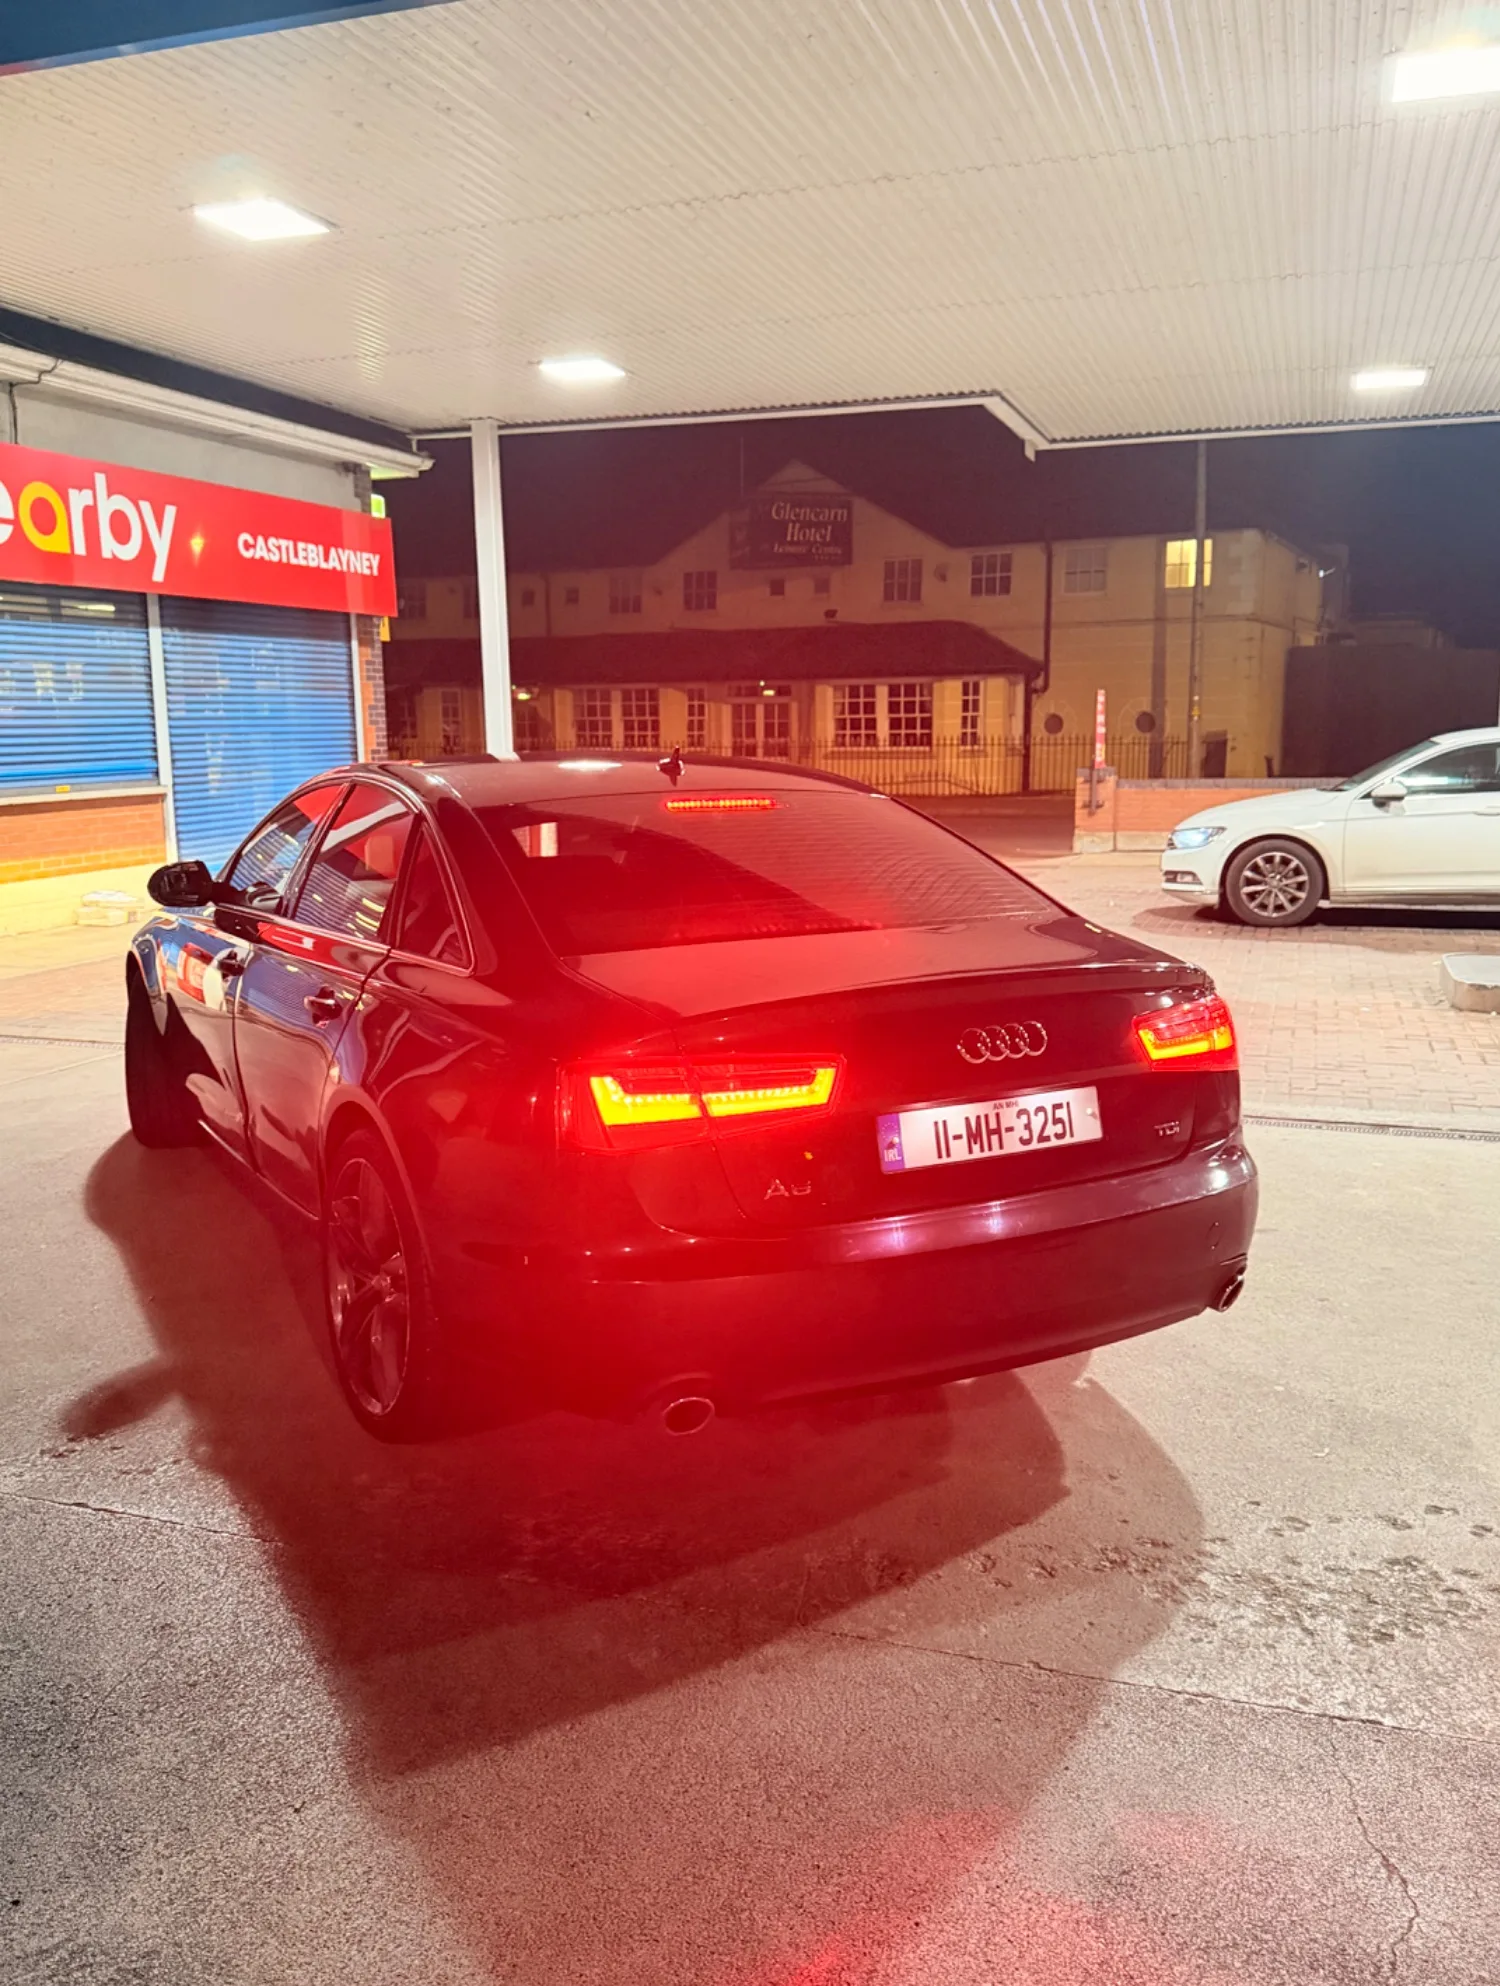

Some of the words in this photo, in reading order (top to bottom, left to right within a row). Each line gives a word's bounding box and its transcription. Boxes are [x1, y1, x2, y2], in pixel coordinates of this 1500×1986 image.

[771, 501, 848, 522] Glencarn
[0, 472, 177, 583] arby
[786, 522, 832, 542] Hotel
[237, 532, 380, 576] CASTLEBLAYNEY
[932, 1101, 1075, 1160] 11-MH-3251
[884, 1148, 902, 1162] IRL
[763, 1178, 812, 1200] A6
